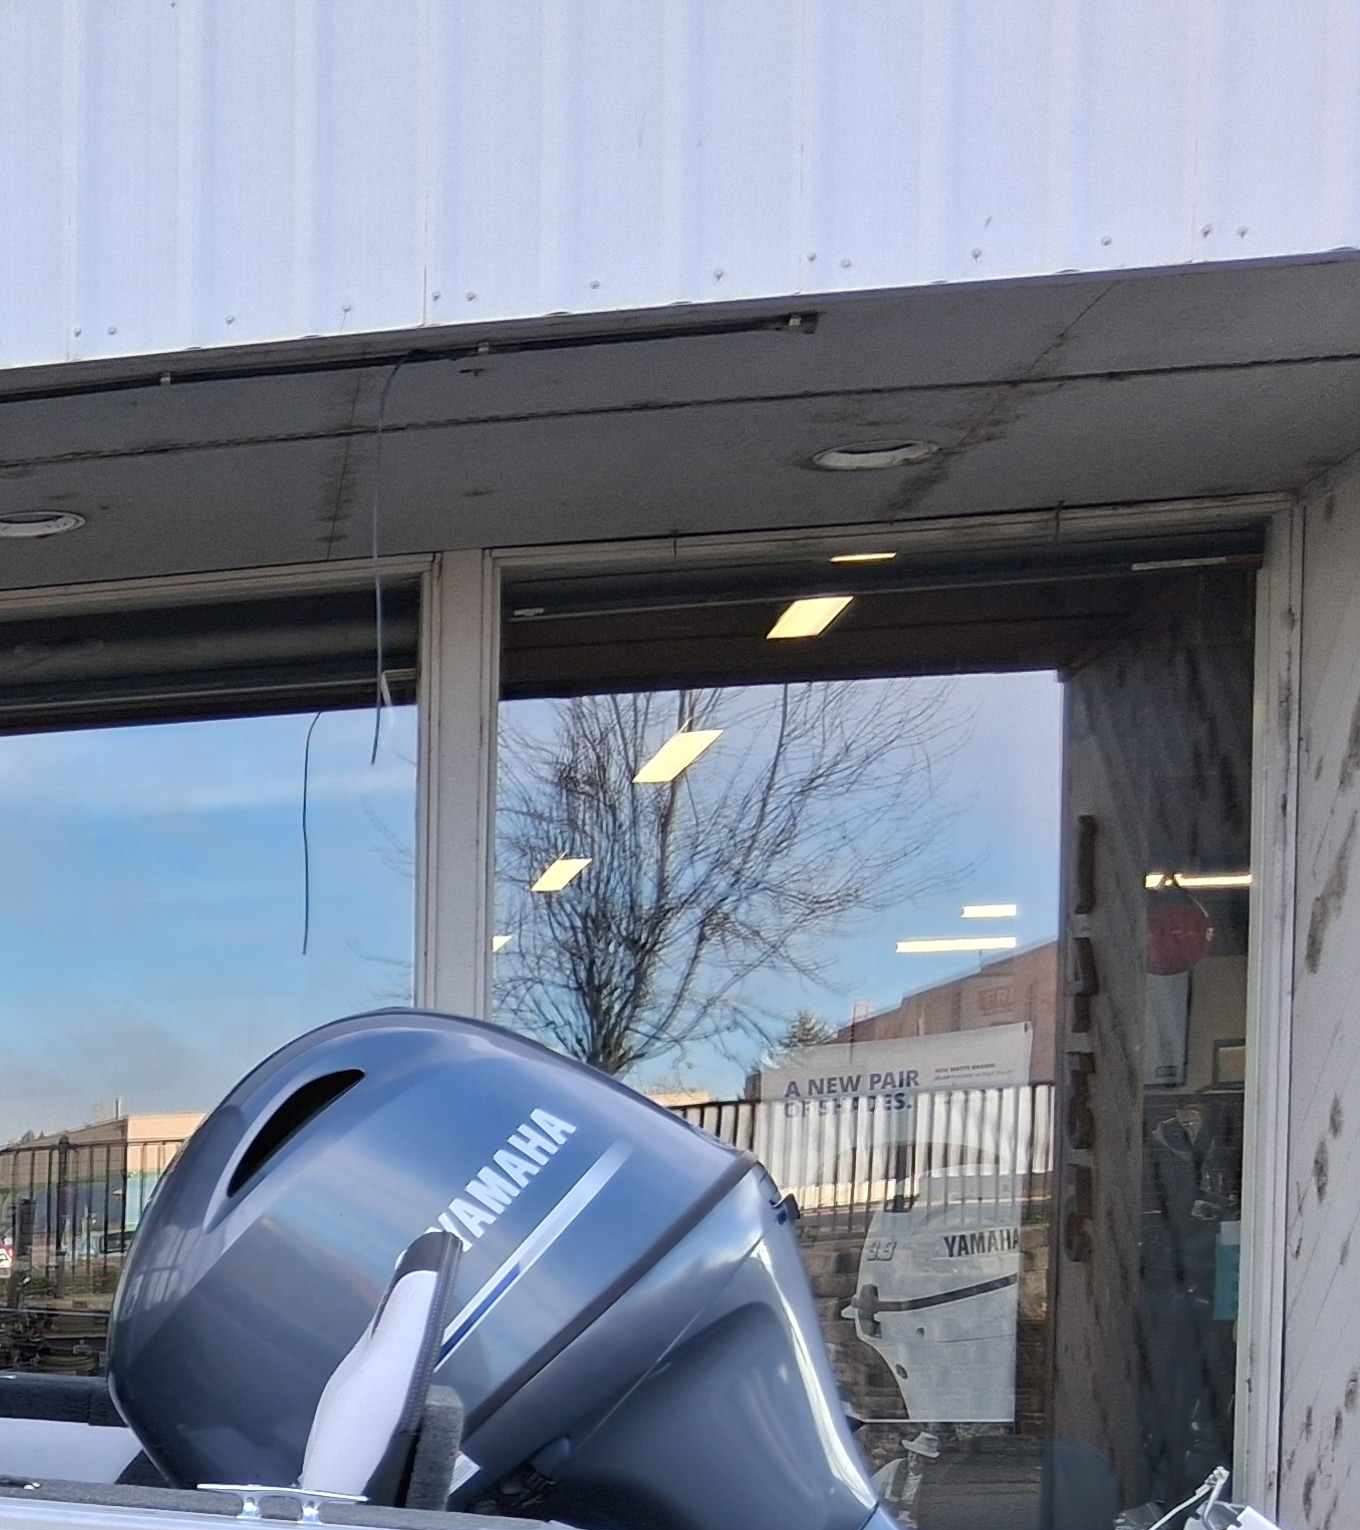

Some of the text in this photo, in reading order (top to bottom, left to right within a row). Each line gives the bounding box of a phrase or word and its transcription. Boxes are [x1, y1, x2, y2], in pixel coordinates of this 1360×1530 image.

[784, 1080, 801, 1098] A
[807, 1075, 861, 1096] NEW
[869, 1069, 920, 1090] PAIR
[423, 1108, 577, 1252] YAMAHA
[943, 1227, 1019, 1258] YAMAHA
